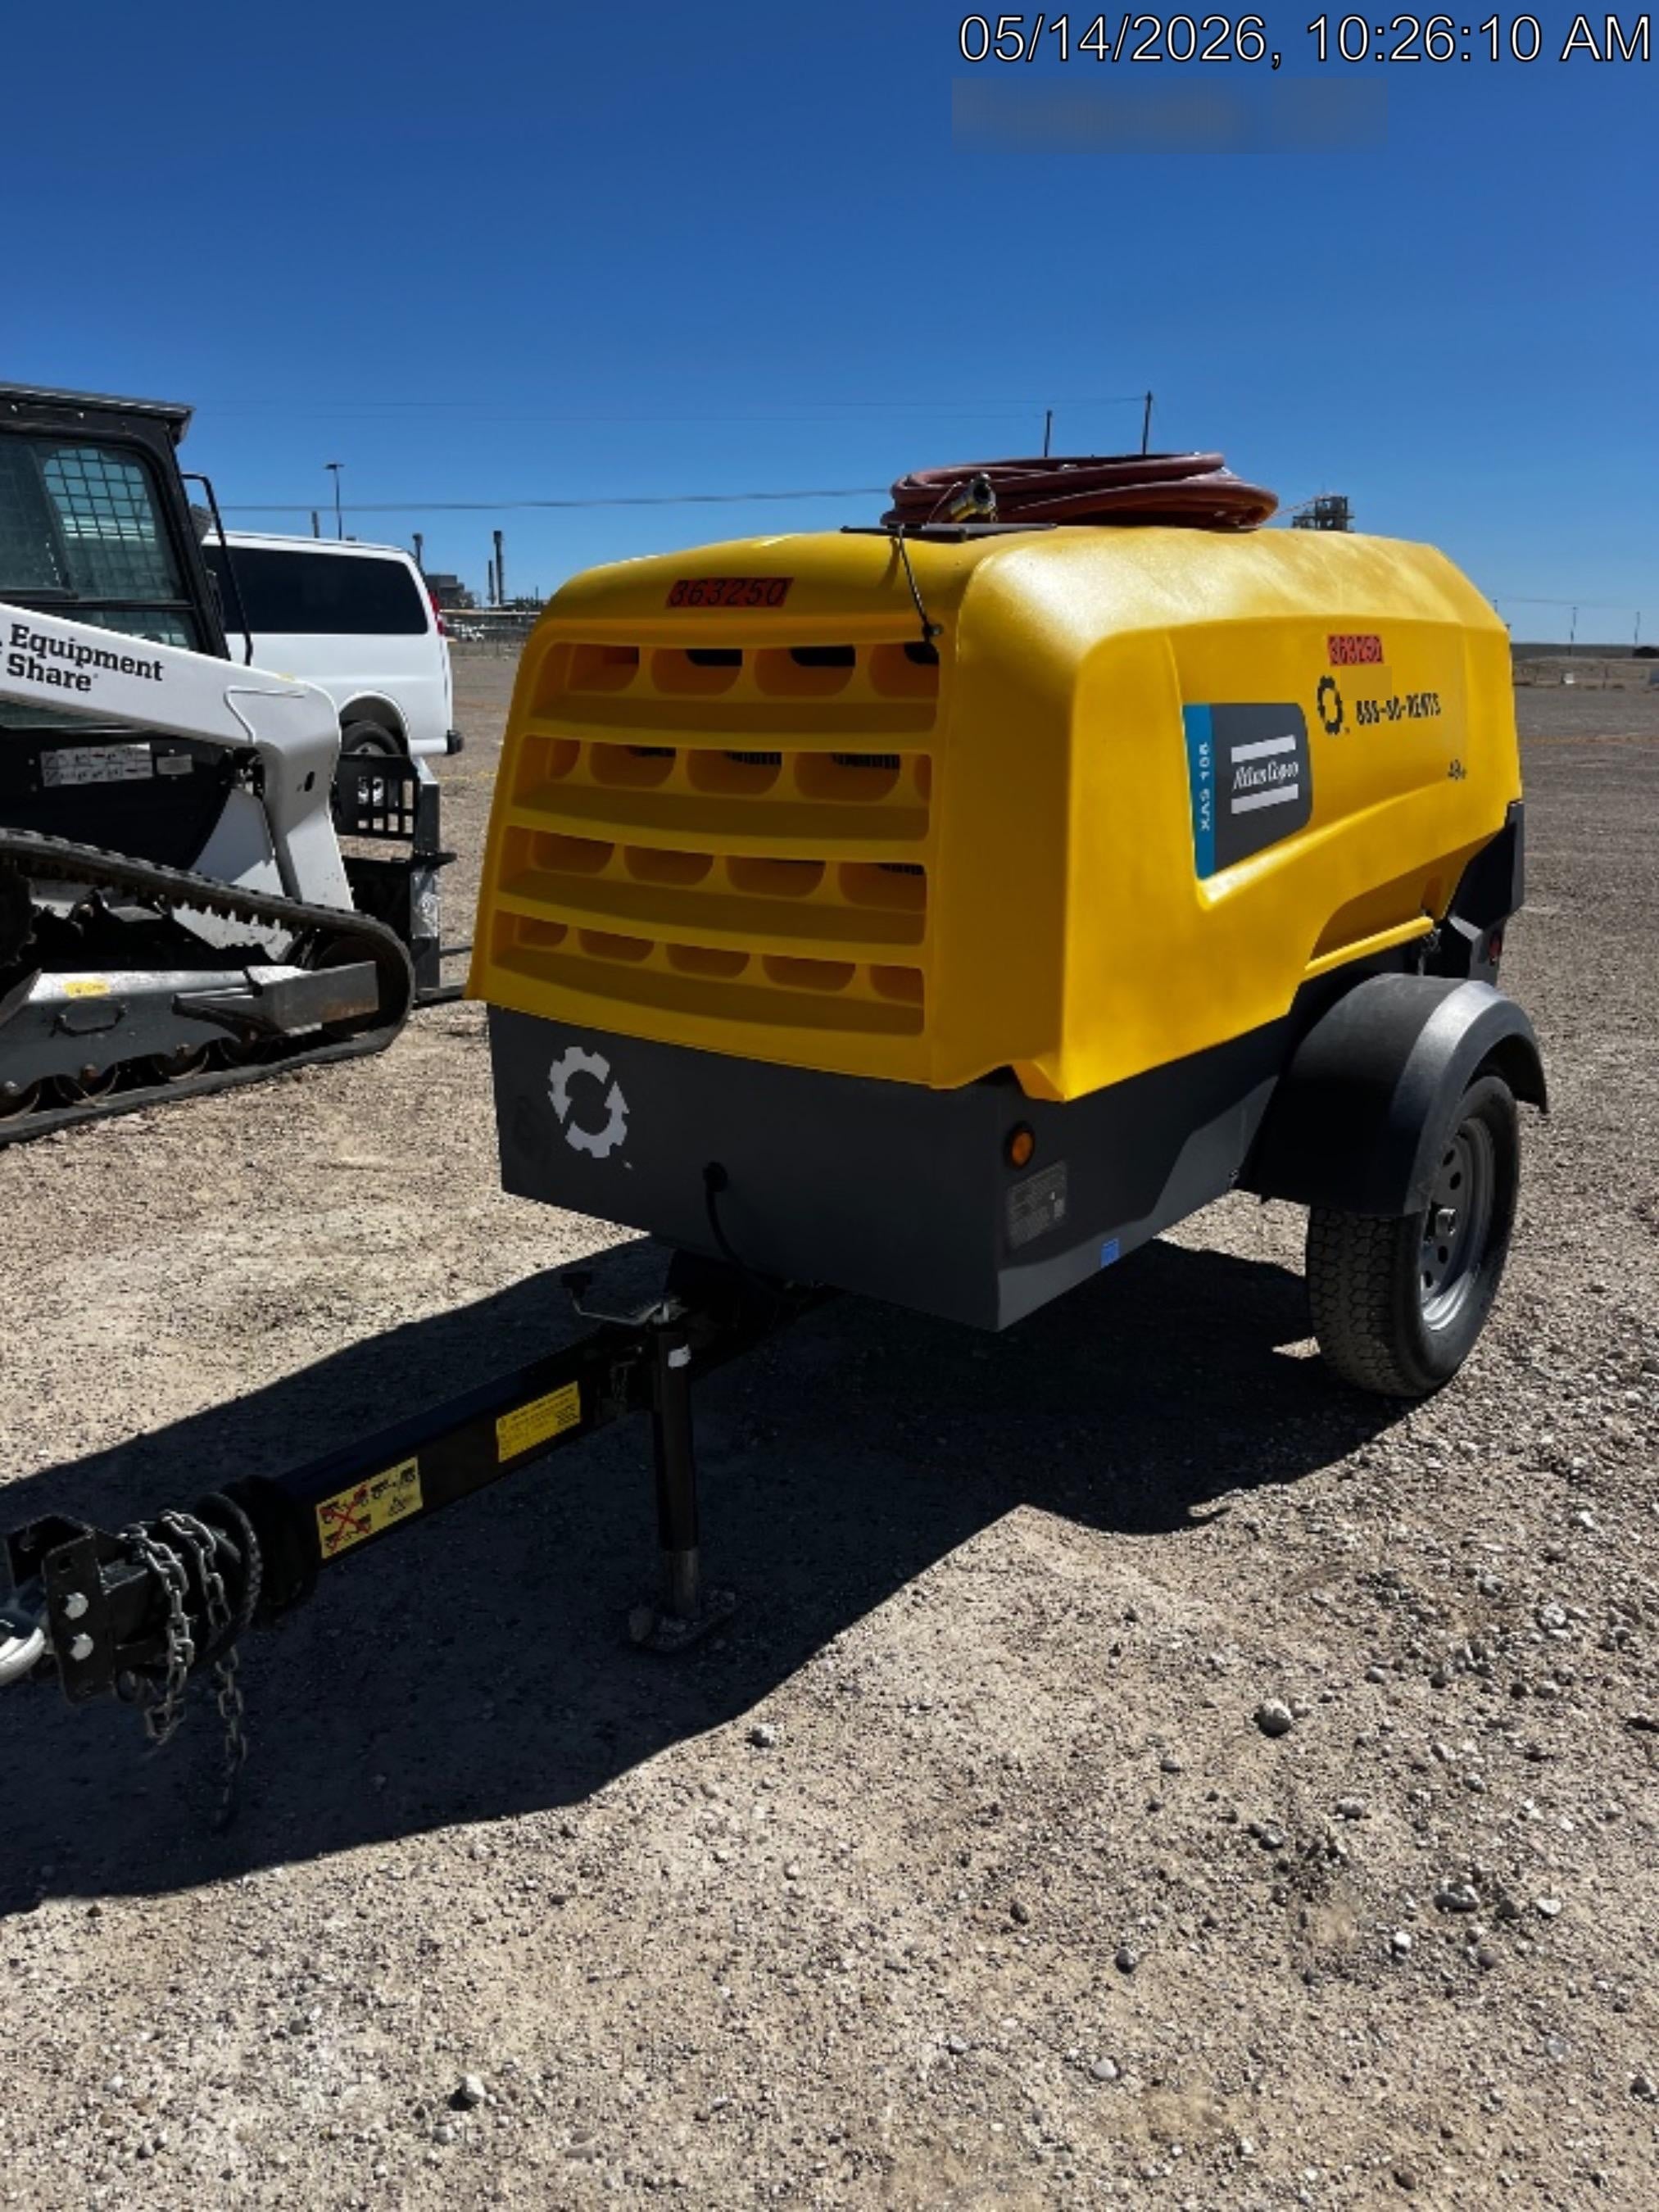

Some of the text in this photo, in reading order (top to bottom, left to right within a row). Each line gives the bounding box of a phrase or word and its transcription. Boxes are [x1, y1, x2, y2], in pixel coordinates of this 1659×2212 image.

[669, 579, 791, 606] 363250
[9, 623, 165, 682] Equipment
[7, 653, 92, 692] Share
